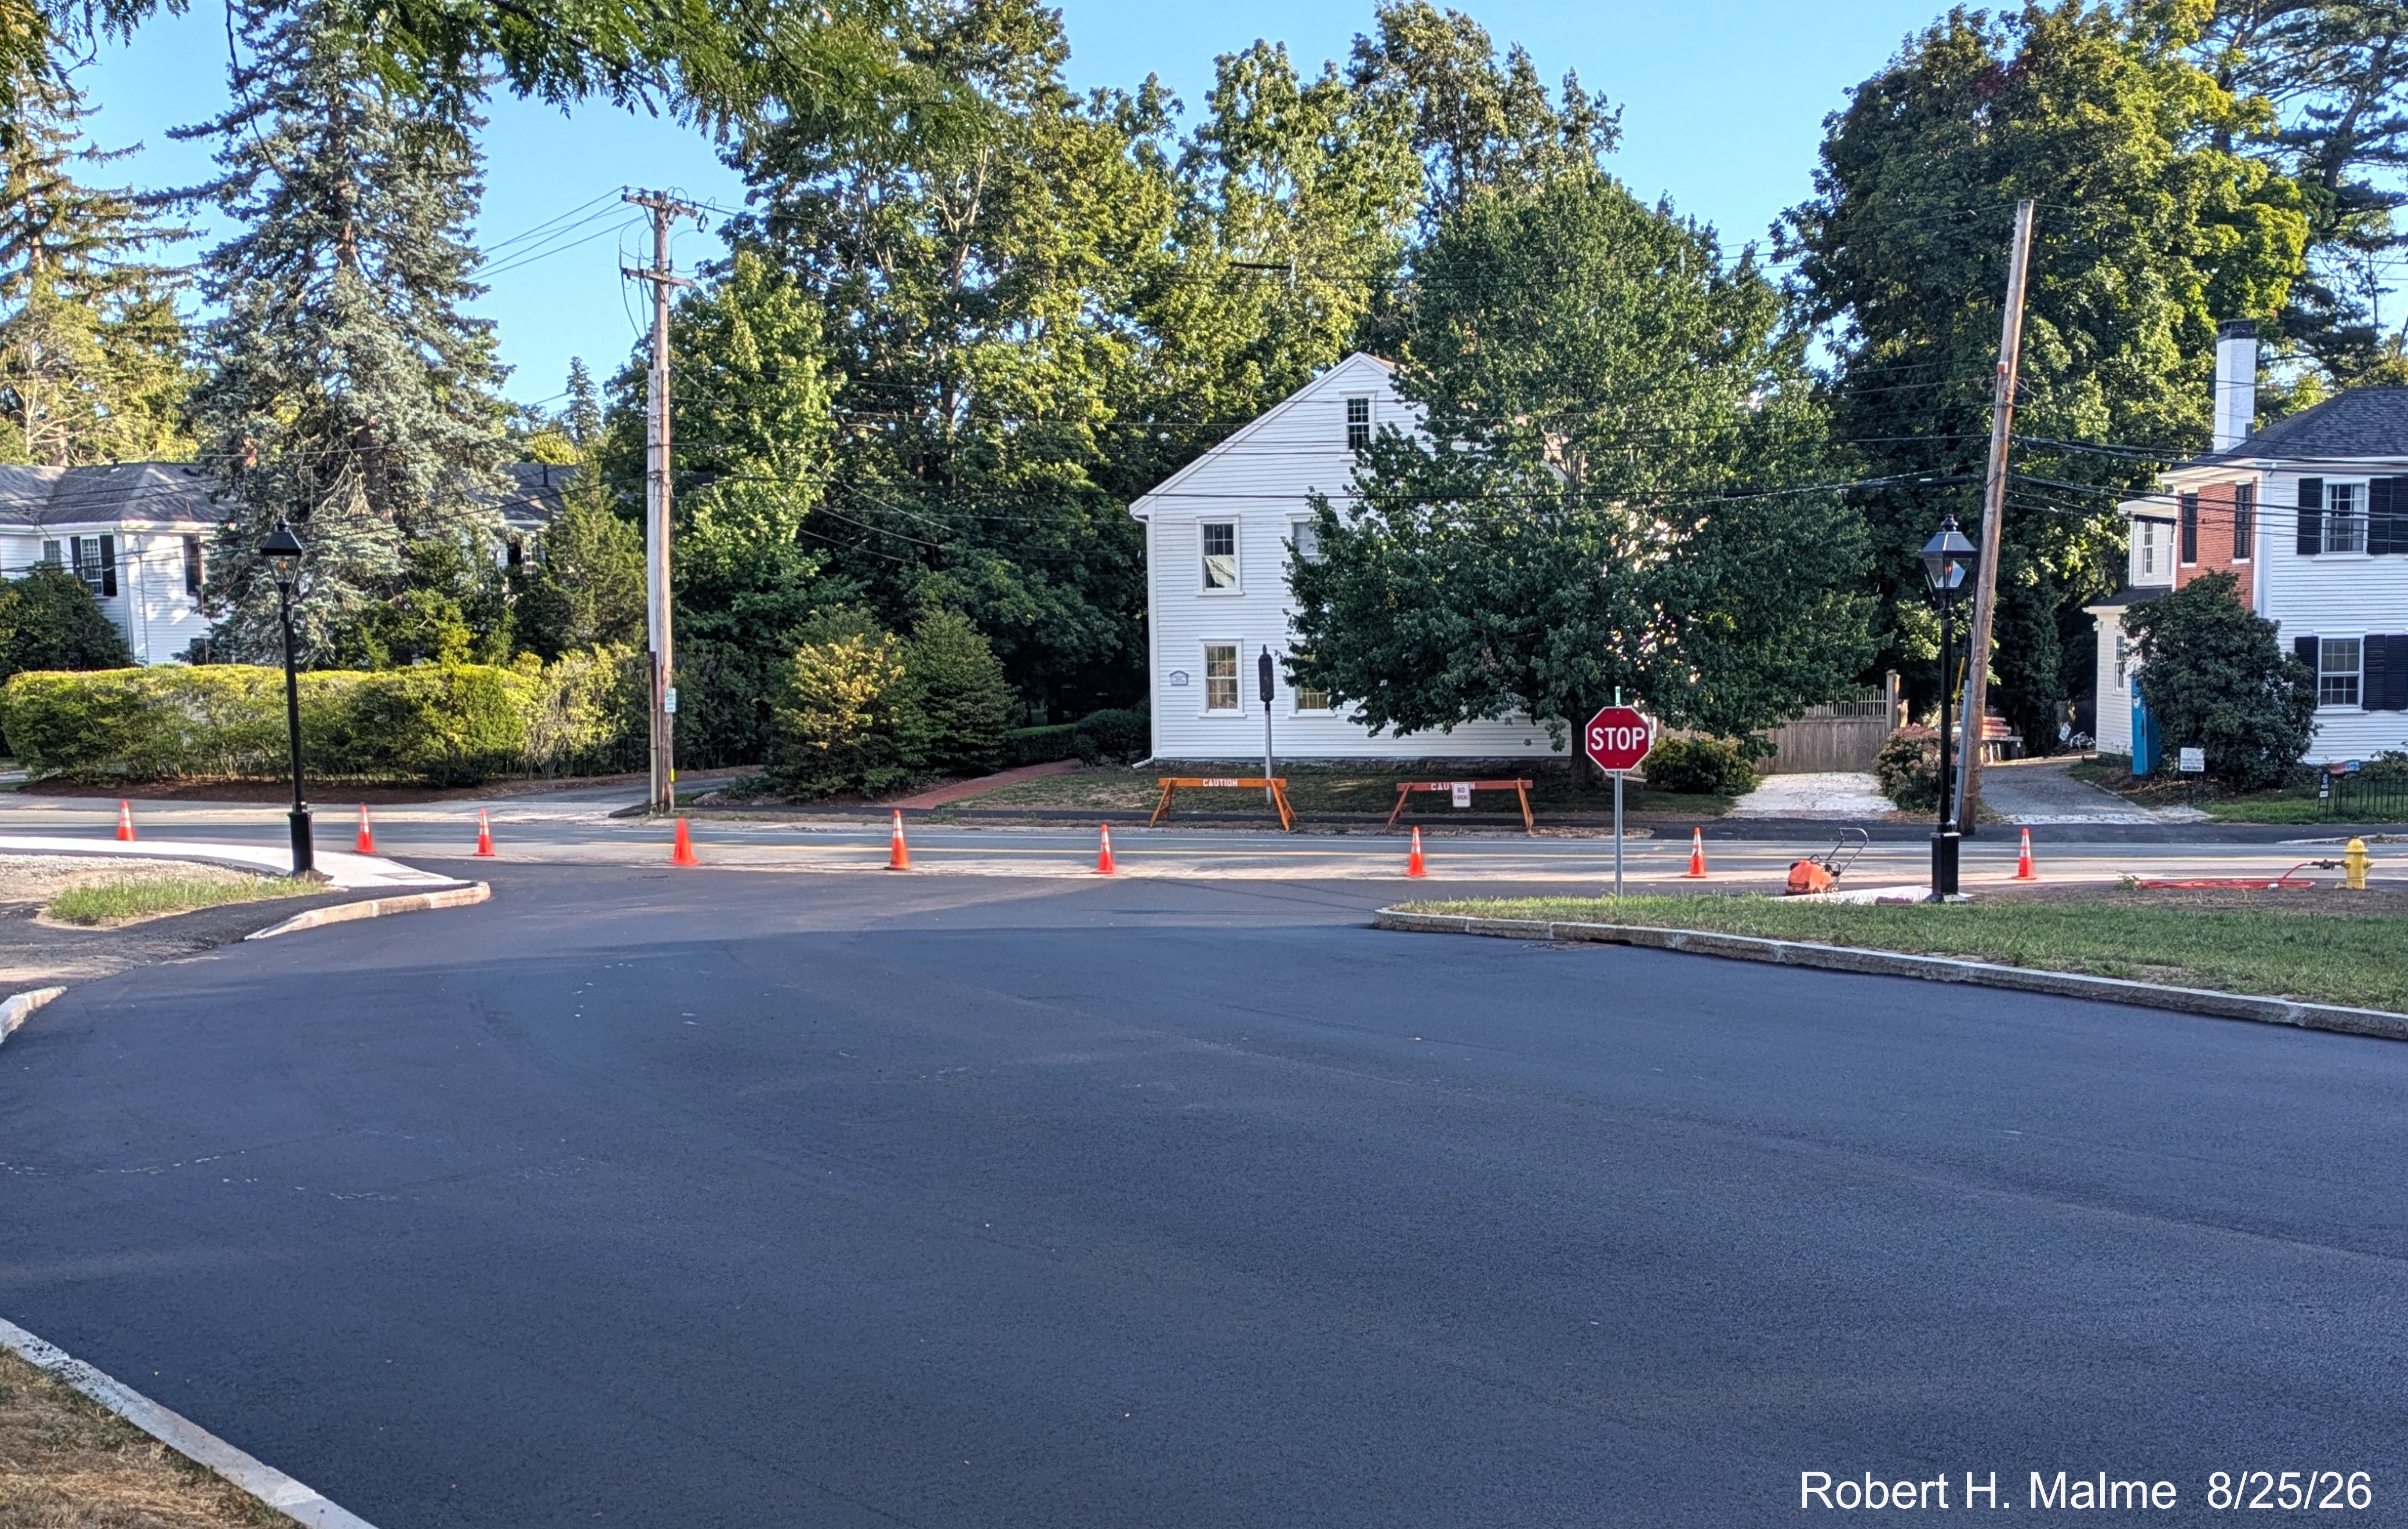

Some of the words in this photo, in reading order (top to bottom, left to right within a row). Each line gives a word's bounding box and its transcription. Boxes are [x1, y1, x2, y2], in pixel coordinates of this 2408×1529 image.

[1591, 727, 1646, 751] STOP
[1202, 778, 1238, 787] CAUTION
[1431, 782, 1475, 791] CAUTN
